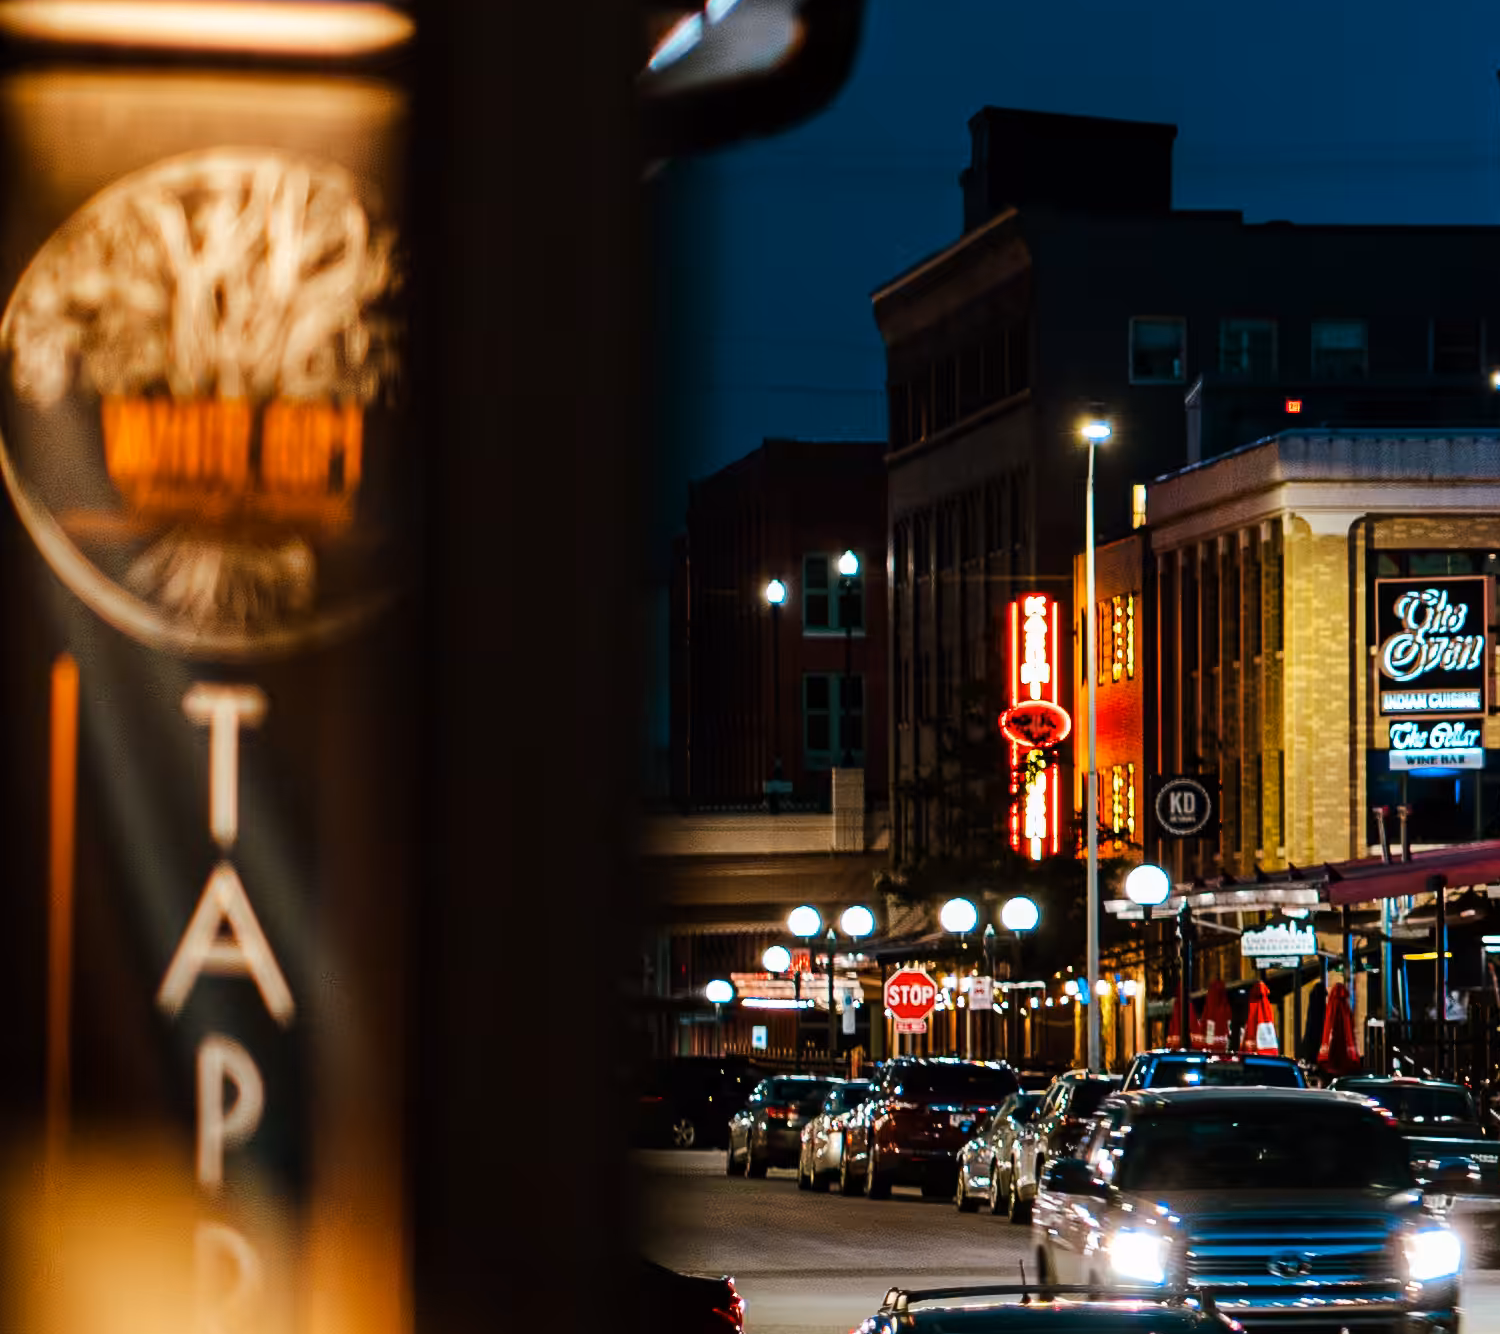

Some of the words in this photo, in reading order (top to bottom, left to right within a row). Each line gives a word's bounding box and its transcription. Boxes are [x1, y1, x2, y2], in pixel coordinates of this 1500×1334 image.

[1384, 692, 1427, 710] INDIAN
[1428, 691, 1480, 709] CUISINE
[1389, 722, 1428, 749] The
[1405, 755, 1438, 766] WINE
[1440, 754, 1466, 765] BAR
[1170, 791, 1196, 815] KD
[888, 984, 934, 1007] STOP
